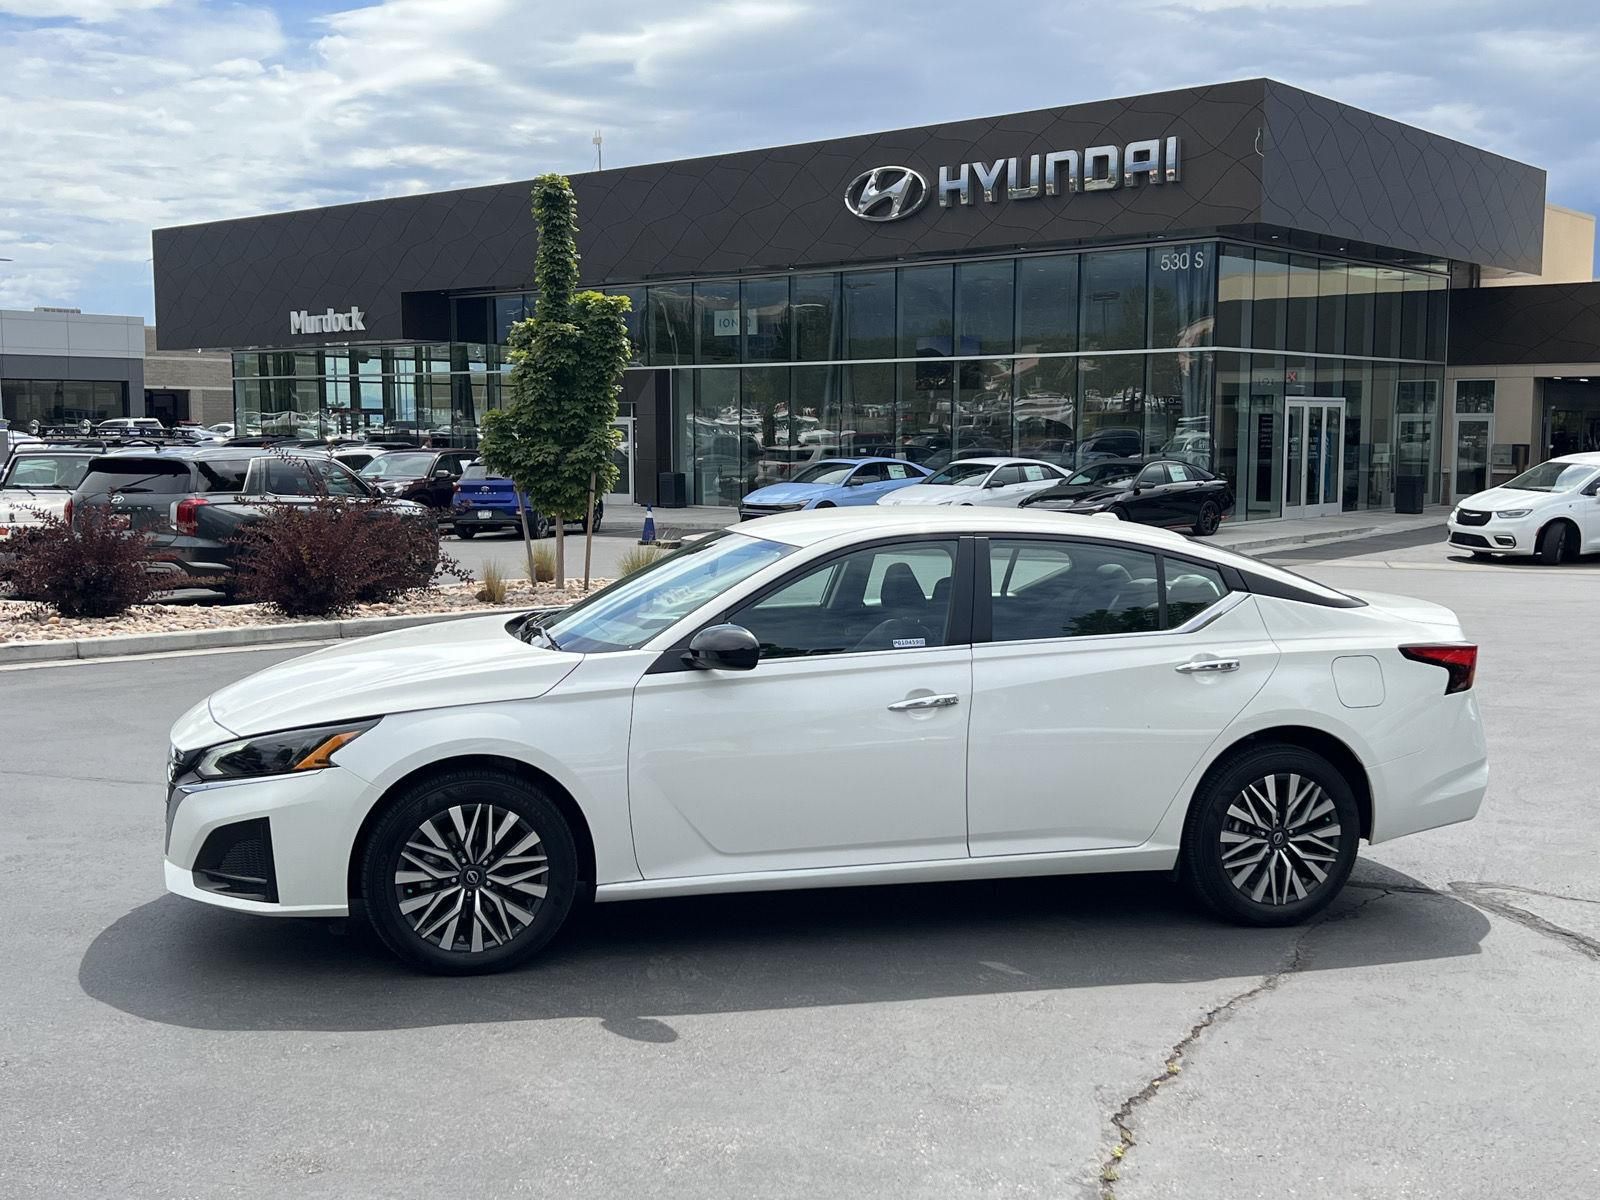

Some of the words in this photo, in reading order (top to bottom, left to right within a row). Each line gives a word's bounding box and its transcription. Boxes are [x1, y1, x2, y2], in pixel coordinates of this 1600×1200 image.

[939, 136, 1180, 207] HYUNDAI
[1160, 252, 1189, 271] 530
[1194, 251, 1204, 269] S
[290, 306, 366, 335] Murdock
